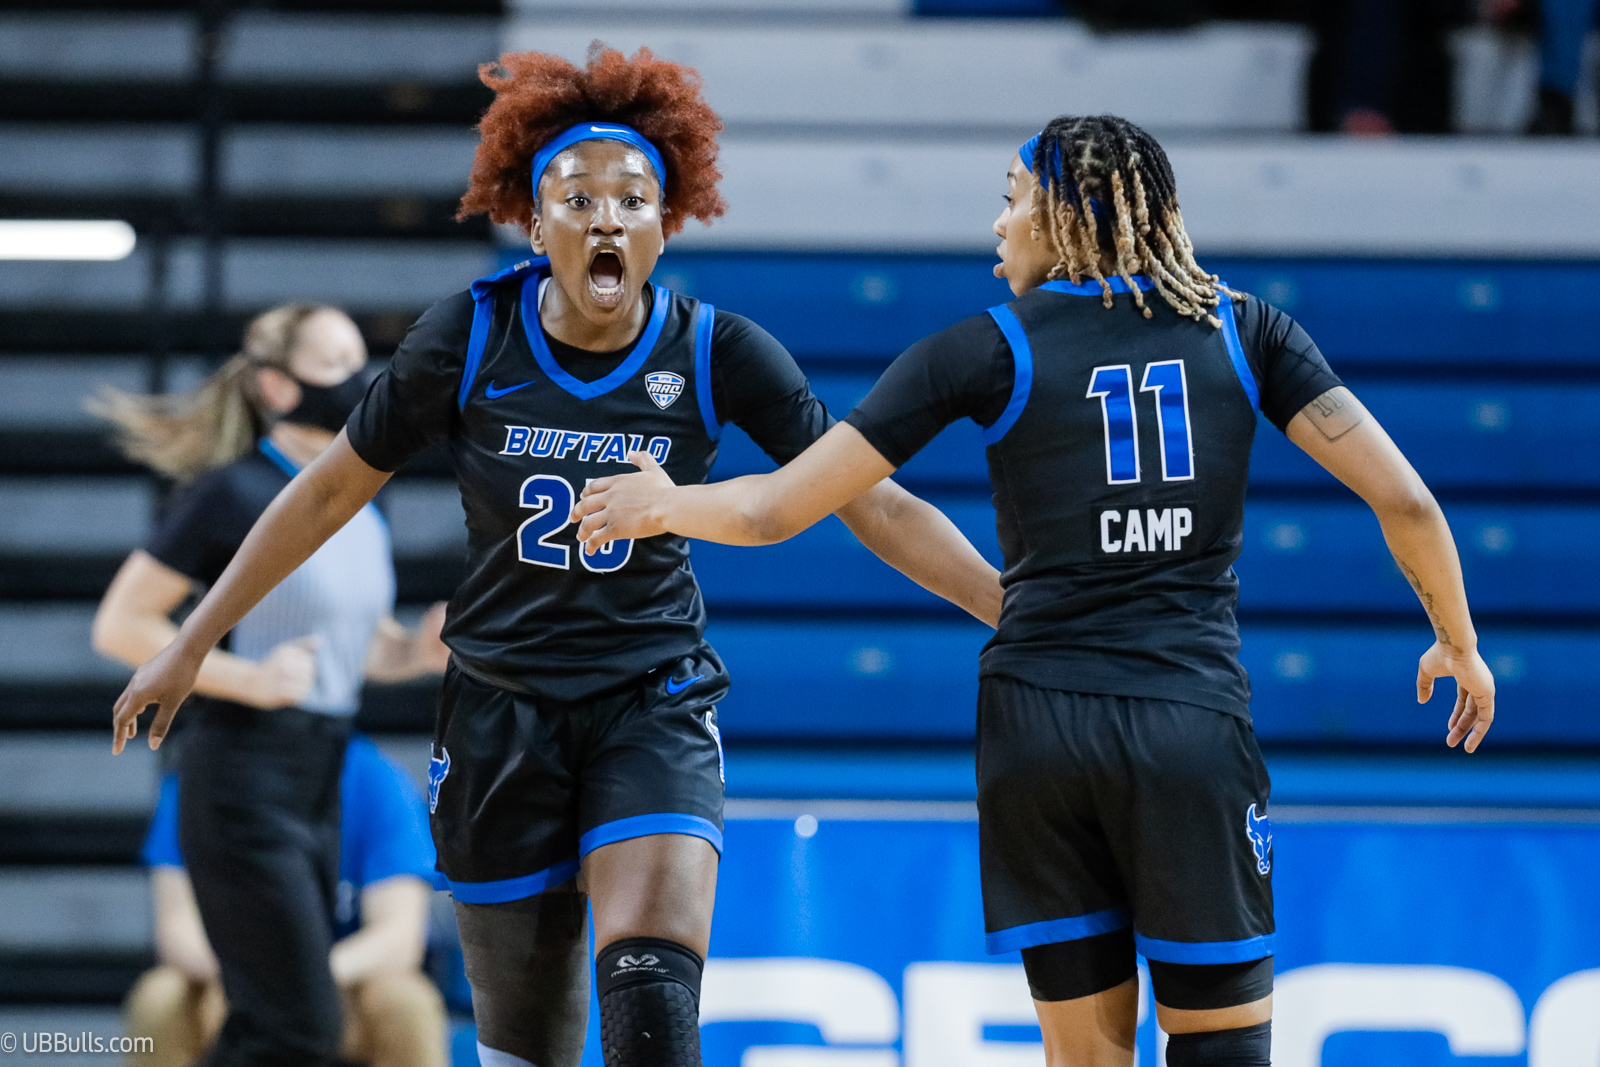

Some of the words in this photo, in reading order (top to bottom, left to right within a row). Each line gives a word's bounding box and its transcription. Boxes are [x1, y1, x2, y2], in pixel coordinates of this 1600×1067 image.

[648, 383, 681, 394] MAC
[1086, 359, 1194, 485] 11
[498, 425, 672, 466] BUFFALO
[1100, 508, 1192, 553] CAMP
